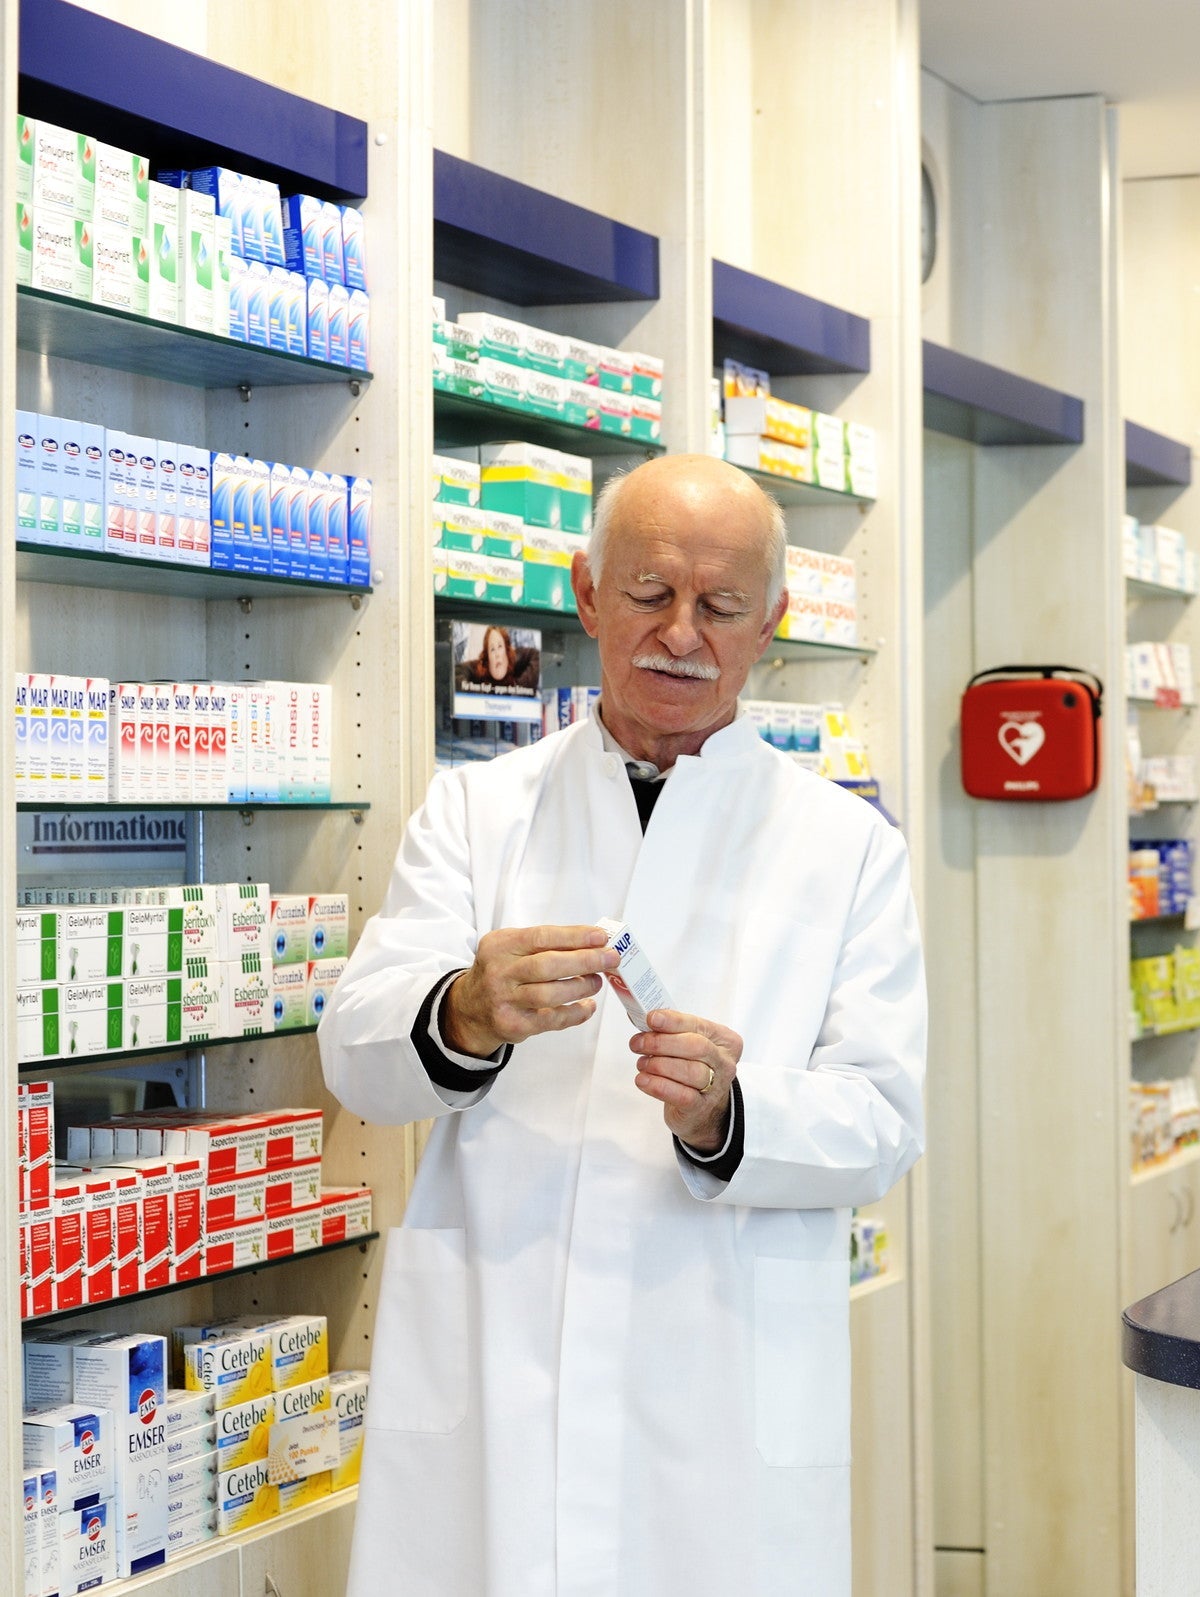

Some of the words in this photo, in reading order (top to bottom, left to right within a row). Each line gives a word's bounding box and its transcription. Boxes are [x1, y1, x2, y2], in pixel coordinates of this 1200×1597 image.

[40, 139, 74, 162] Sinupret
[99, 160, 129, 181] Sinupret
[37, 226, 72, 247] Sinupret
[97, 243, 130, 263] Sinupret
[16, 687, 26, 706] AR
[30, 688, 48, 707] MAR
[51, 689, 68, 708] MAR
[88, 692, 107, 710] MAR
[121, 695, 135, 709] SNUP
[140, 697, 154, 710] SNUP
[175, 694, 190, 709] SNUP
[195, 696, 209, 711] SNUP
[211, 696, 226, 711] SNUP
[156, 697, 170, 711] SNUP
[288, 690, 297, 748] nasic
[310, 692, 319, 748] nasic
[276, 904, 306, 919] Curazink
[314, 901, 346, 915] Curazink
[16, 917, 37, 930] Myrtol
[68, 915, 105, 928] GeloMyrtol
[129, 911, 165, 924] GeloMyrtol
[184, 916, 208, 929] eritox
[233, 912, 266, 927] Esberitox
[612, 932, 631, 955] NUP
[273, 969, 304, 985] Curazink
[67, 988, 104, 1002] GeloMyrtol
[129, 984, 164, 996] GeloMyrtol
[234, 988, 269, 1002] Esberitox
[17, 992, 38, 1006] Myrtol
[183, 992, 212, 1006] sberitox
[268, 1126, 294, 1137] Aspecton
[211, 1136, 238, 1148] Aspecton
[146, 1176, 172, 1188] Aspecton
[178, 1171, 203, 1182] Aspecton
[267, 1172, 293, 1183] Aspecton
[92, 1189, 116, 1202] Aspecton
[119, 1184, 141, 1197] Aspecton
[209, 1184, 236, 1196] Aspecton
[61, 1196, 85, 1207] Aspecton
[323, 1205, 347, 1216] Aspecton
[268, 1217, 294, 1230] Aspecton
[207, 1231, 235, 1244] Aspecton
[279, 1325, 321, 1354] Cetebe
[221, 1342, 265, 1371] Cetebe
[203, 1352, 215, 1390] Ceteb
[283, 1385, 324, 1415] Cetebe
[335, 1385, 368, 1418] Cete
[140, 1398, 155, 1417] EMS
[222, 1404, 267, 1434] Cetebe
[129, 1425, 165, 1453] EMSER
[74, 1453, 101, 1473] EMSER
[168, 1472, 183, 1484] Nisita
[41, 1505, 57, 1517] EMSER
[168, 1501, 183, 1512] Nisita
[24, 1512, 38, 1522] MSER
[168, 1531, 183, 1542] Nisita
[80, 1539, 106, 1560] EMSER
